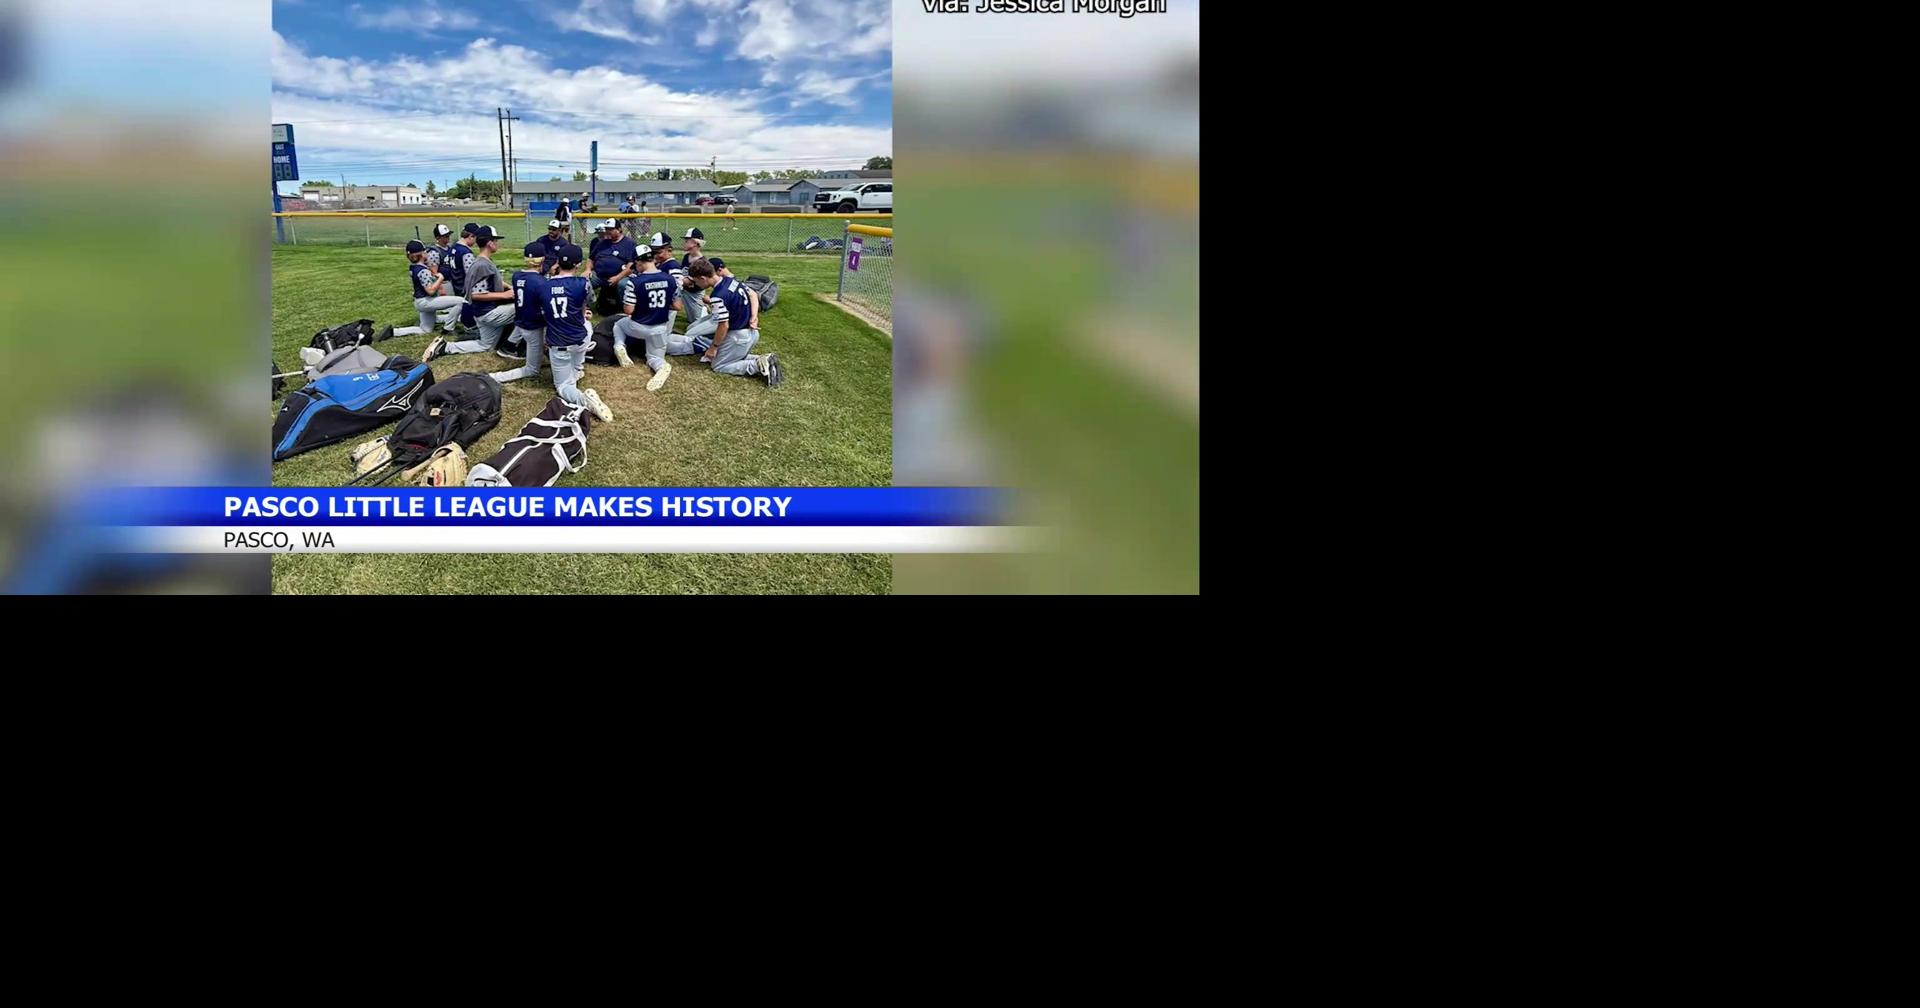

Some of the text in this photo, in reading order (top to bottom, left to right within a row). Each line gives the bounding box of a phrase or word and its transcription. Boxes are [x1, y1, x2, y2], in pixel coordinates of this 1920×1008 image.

[273, 155, 290, 163] HOME
[550, 296, 568, 319] 17
[648, 289, 666, 309] 33
